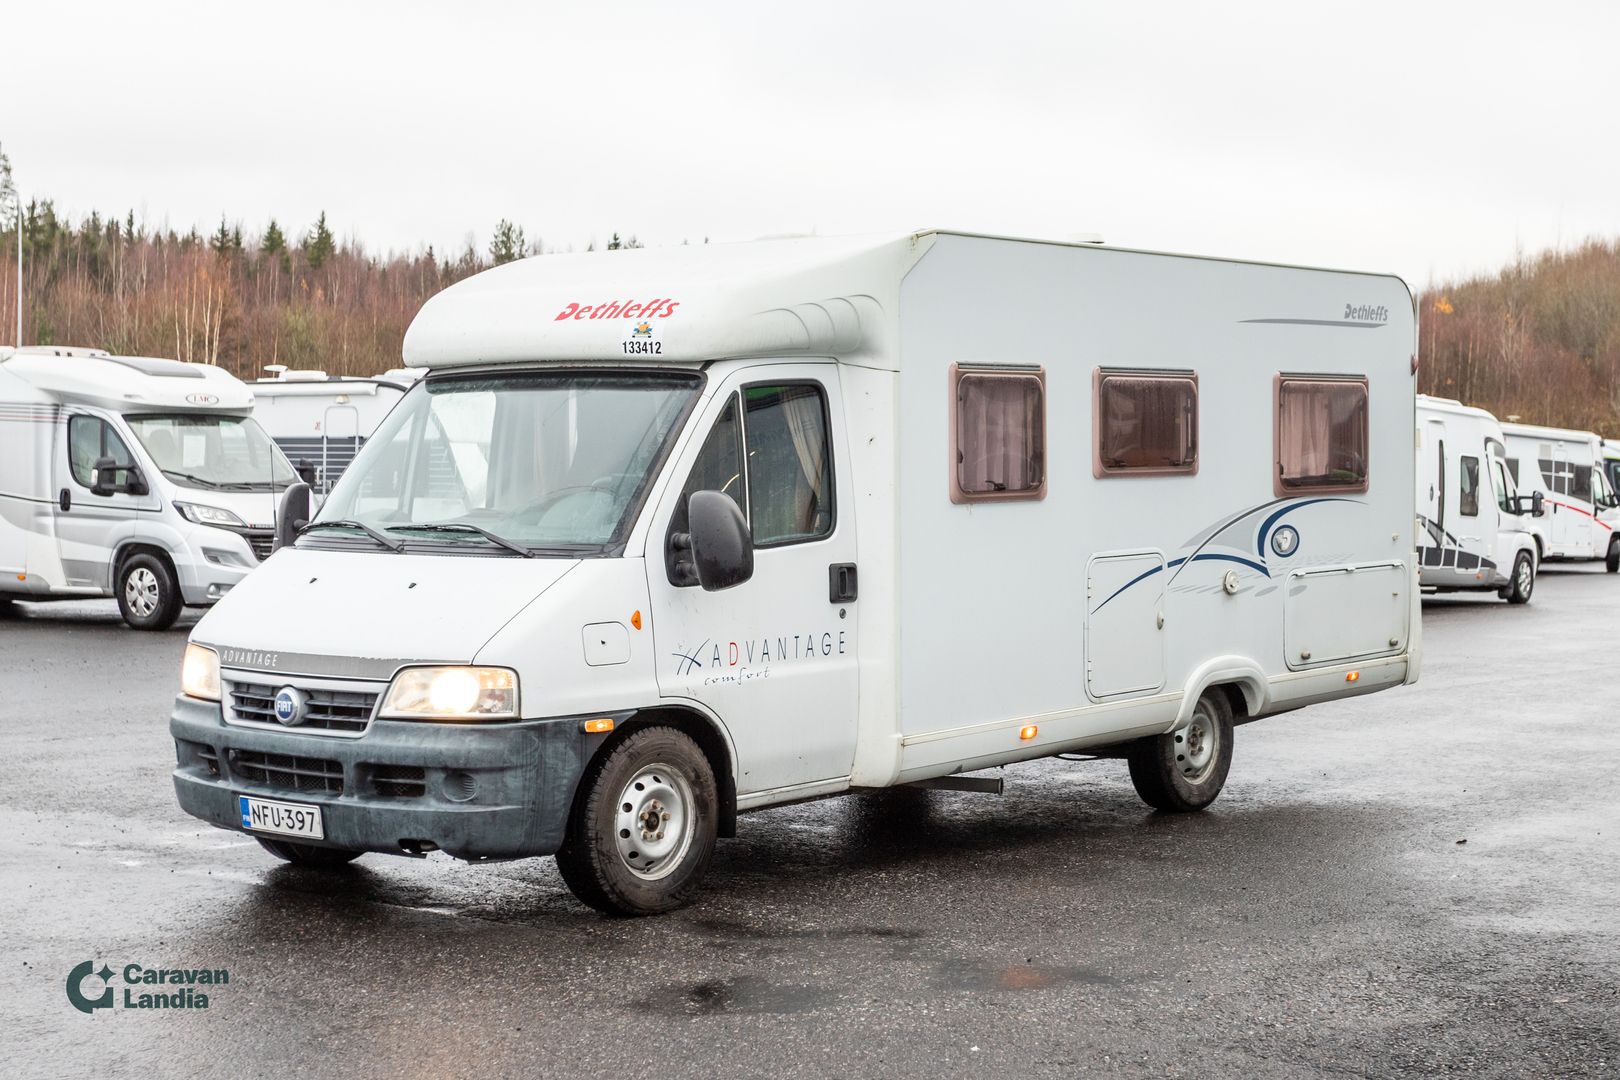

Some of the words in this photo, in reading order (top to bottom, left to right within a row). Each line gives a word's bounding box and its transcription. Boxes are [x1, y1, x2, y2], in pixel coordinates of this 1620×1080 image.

[554, 298, 680, 321] Dethleffs
[1344, 303, 1389, 321] Dethleffs
[622, 341, 662, 354] 133412
[222, 650, 279, 667] ADVANTAGE
[711, 631, 845, 668] ADVANTAGE
[704, 666, 771, 686] comfort
[276, 699, 293, 713] FIAT
[251, 804, 315, 833] NFU-397
